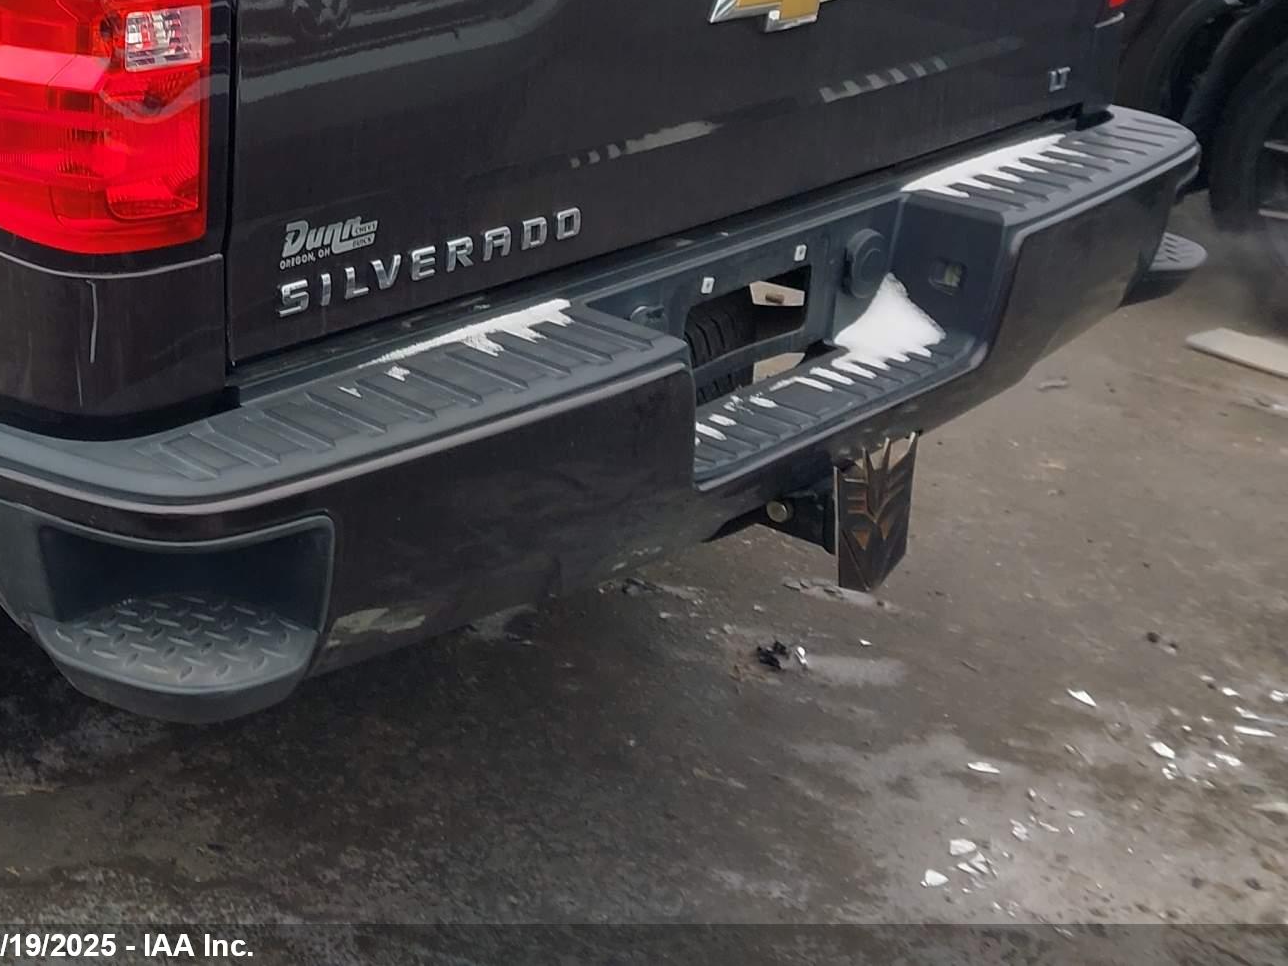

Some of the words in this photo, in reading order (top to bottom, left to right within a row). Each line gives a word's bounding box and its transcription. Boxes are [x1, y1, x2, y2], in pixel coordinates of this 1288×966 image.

[1048, 66, 1071, 92] LT
[282, 216, 370, 258] Dunn
[318, 248, 330, 259] OH
[278, 207, 583, 318] SILVERADO
